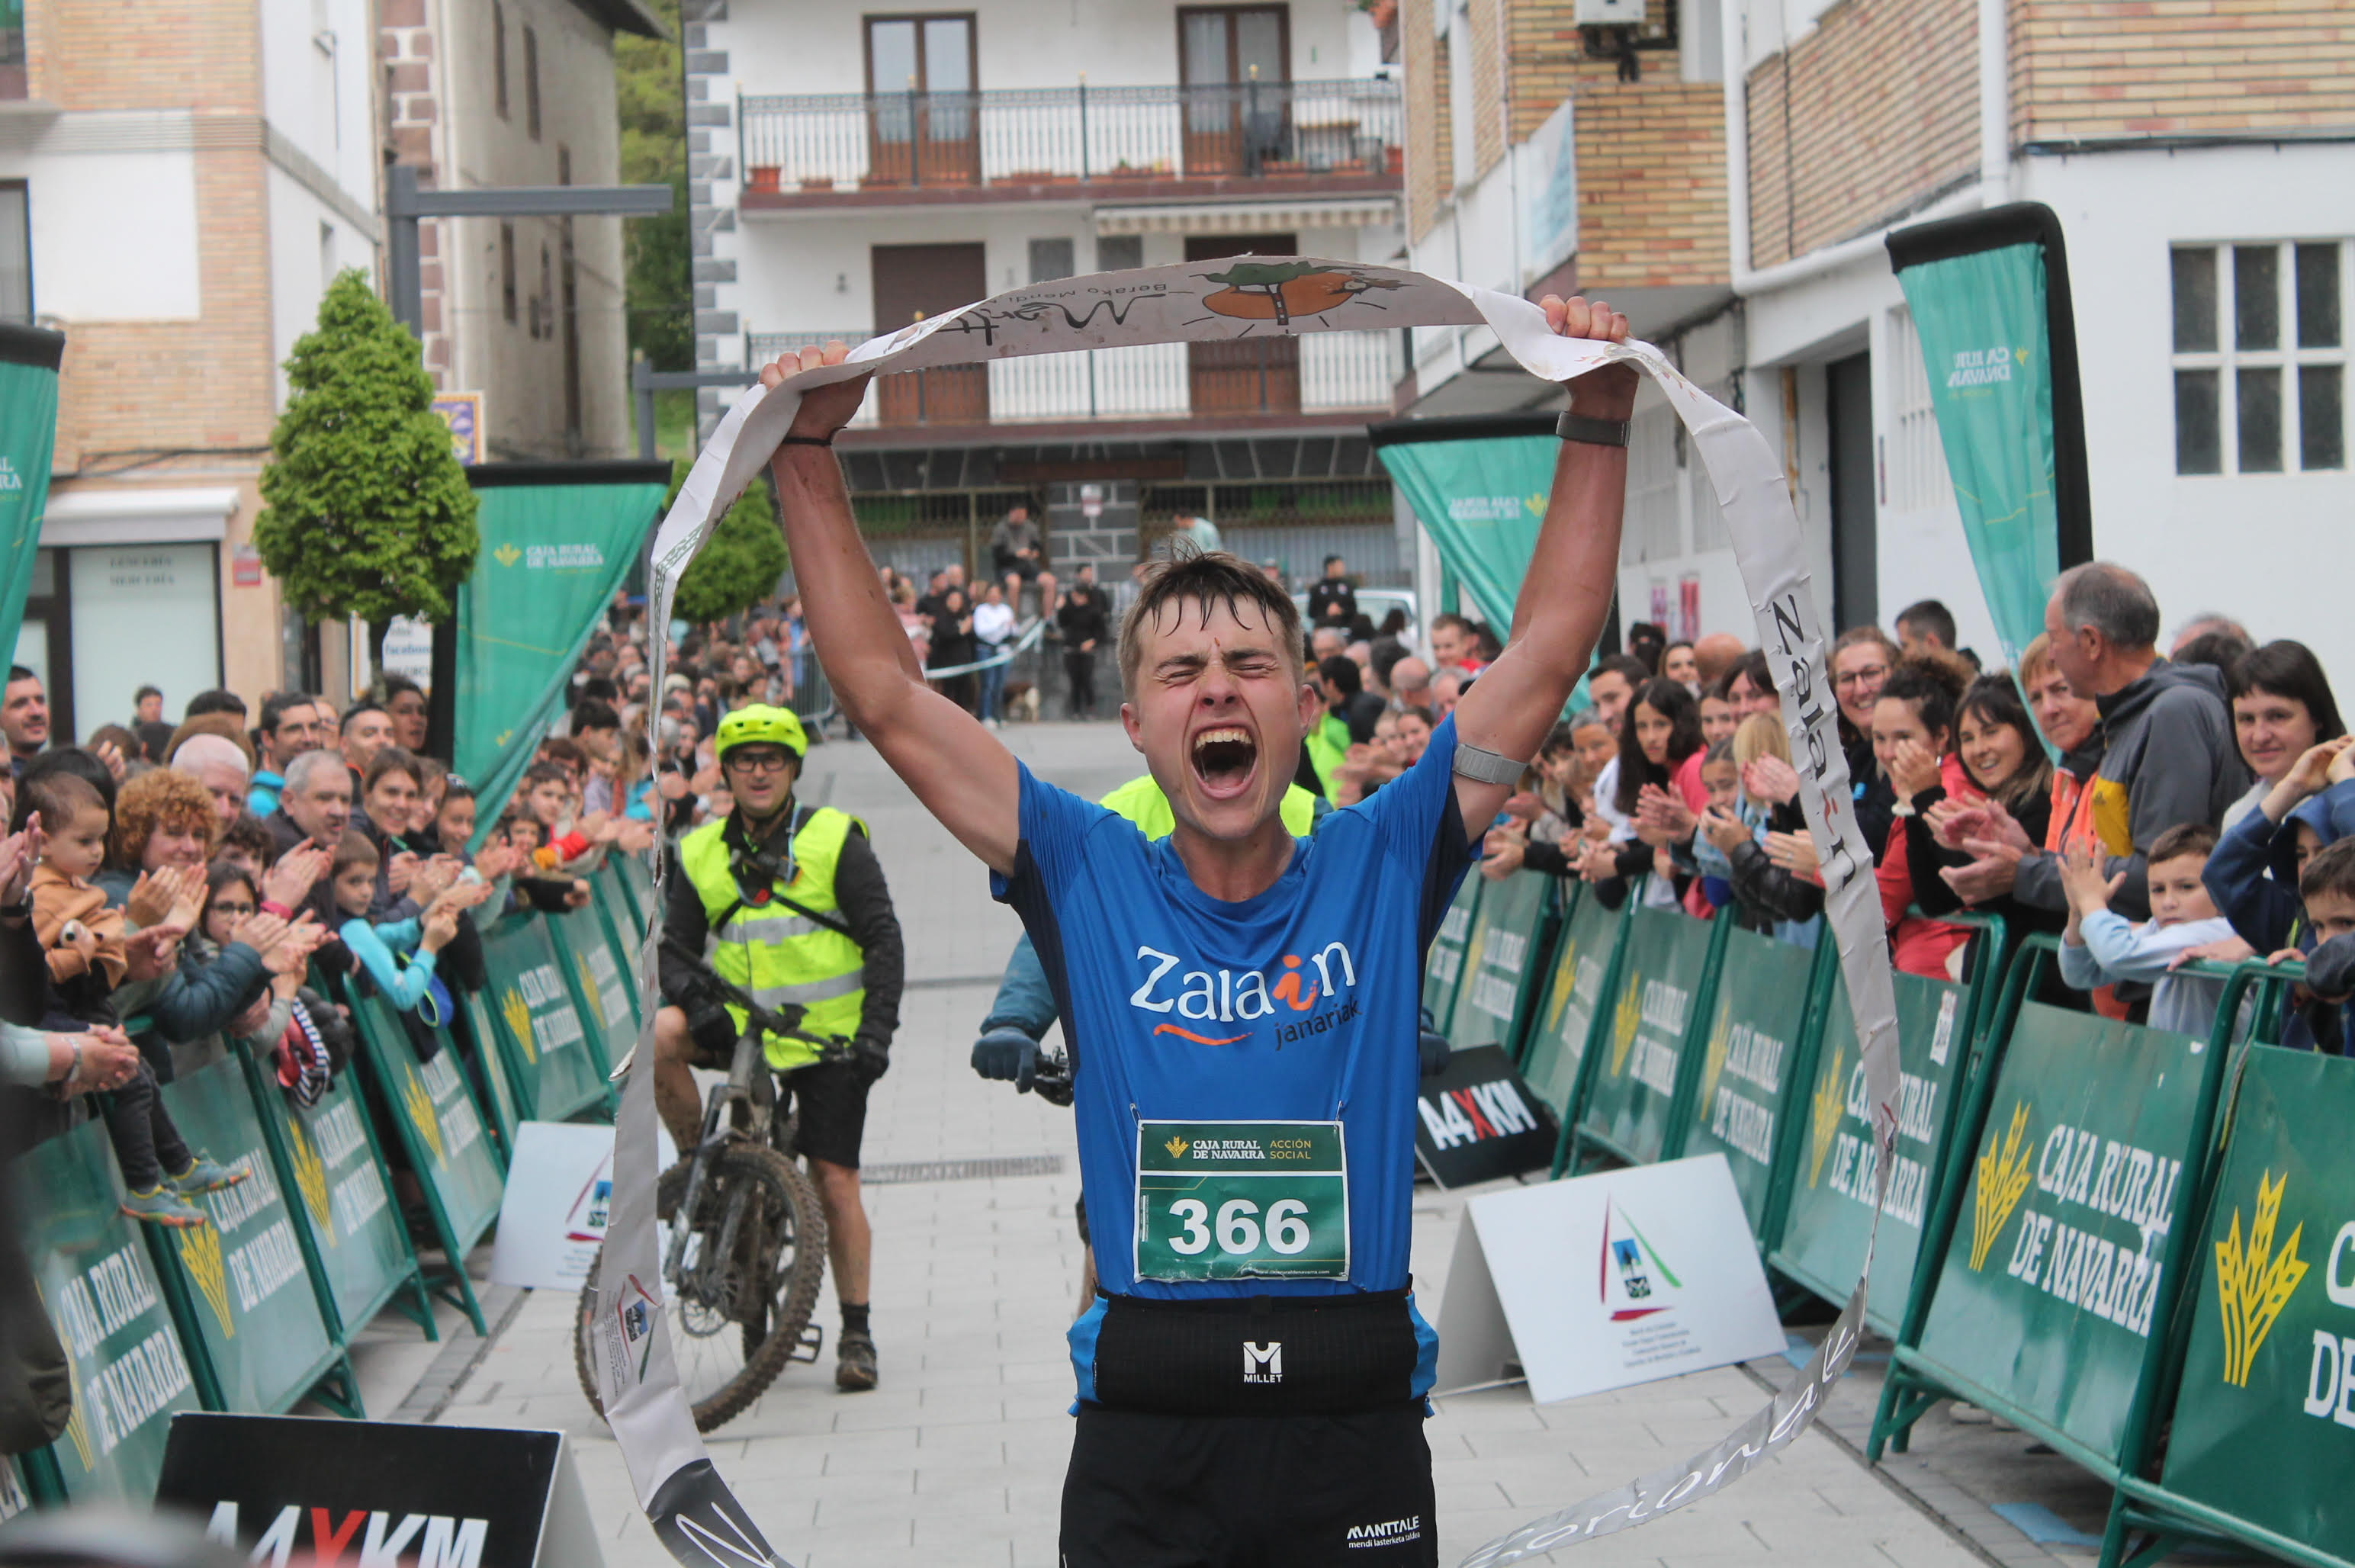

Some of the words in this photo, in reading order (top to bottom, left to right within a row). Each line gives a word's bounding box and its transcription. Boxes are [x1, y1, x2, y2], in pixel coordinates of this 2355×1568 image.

[1009, 290, 1076, 304] Mendi
[1088, 283, 1167, 296] Berako
[1129, 941, 1356, 1022] Zalain
[1274, 994, 1362, 1052] janariak
[1417, 1078, 1538, 1152] A4XKM
[1192, 1140, 1220, 1150] CAJA
[1222, 1140, 1261, 1150] RURAL
[1192, 1150, 1209, 1160] DE
[1211, 1150, 1266, 1160] NAVARRA
[1269, 1138, 1312, 1149] ACCIÓN
[1269, 1151, 1312, 1160] SOCIAL
[1829, 1132, 1859, 1194] DE
[2037, 1123, 2099, 1206] CAJA
[2088, 1139, 2182, 1237] RURAL
[1168, 1198, 1311, 1255] 366
[88, 1242, 157, 1337] RURAL
[2006, 1208, 2054, 1287] DE
[2041, 1222, 2163, 1338] NAVARRA
[102, 1323, 191, 1439] NAVARRA
[1243, 1374, 1283, 1383] MILLET
[1346, 1515, 1420, 1540] MANTTALE
[1348, 1539, 1373, 1549] mendi
[1373, 1536, 1405, 1547] lasterketa
[1405, 1531, 1421, 1541] taldea
